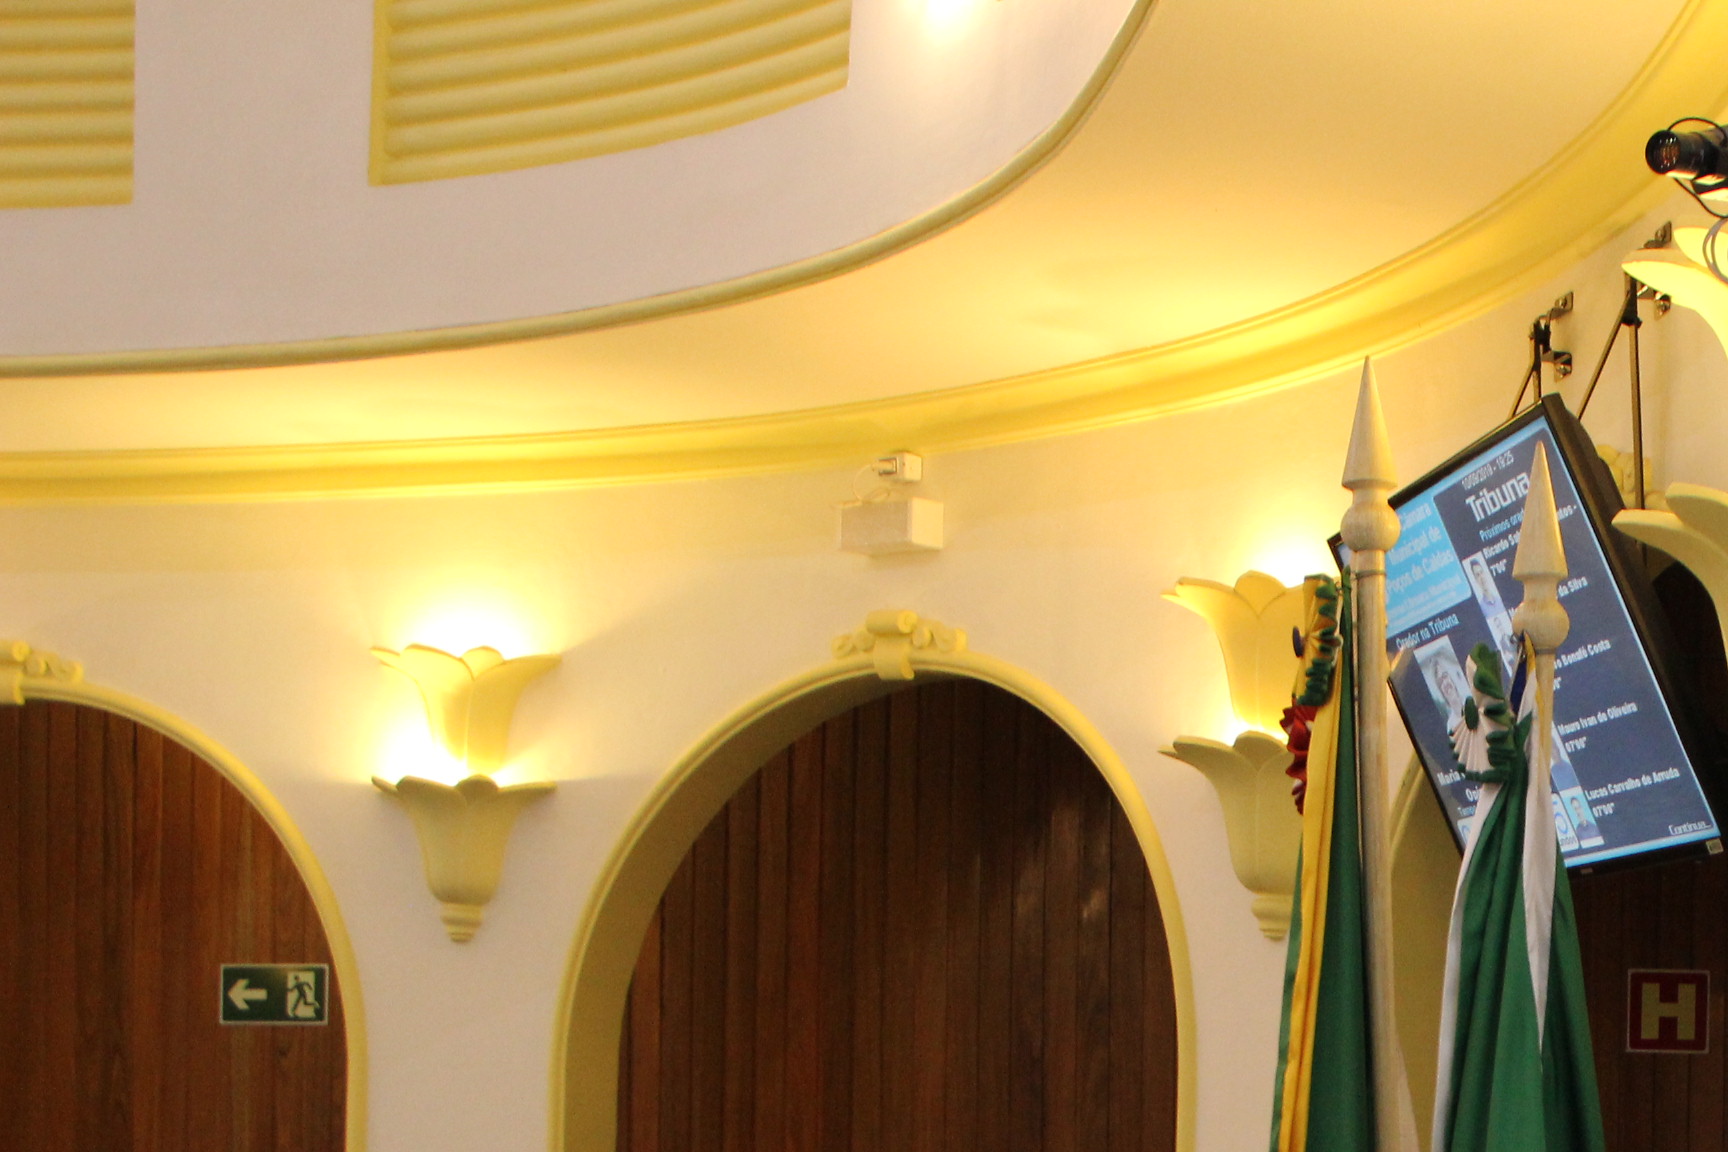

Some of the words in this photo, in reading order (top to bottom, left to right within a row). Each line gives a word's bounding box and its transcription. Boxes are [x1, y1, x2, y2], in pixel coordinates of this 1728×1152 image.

[1465, 472, 1530, 522] Tribuna
[1482, 539, 1509, 559] Ricardo
[1567, 576, 1588, 592] Silva
[1420, 628, 1431, 640] na
[1428, 613, 1459, 635] Tribuna
[1587, 639, 1612, 656] Costa
[1579, 714, 1598, 729] Ivan
[1607, 701, 1638, 719] Oliveira
[1437, 769, 1460, 786] Maria
[1585, 786, 1609, 800] Lucas
[1608, 777, 1642, 795] Carvalho
[1652, 767, 1681, 784] Arruda
[1641, 983, 1696, 1040] H
